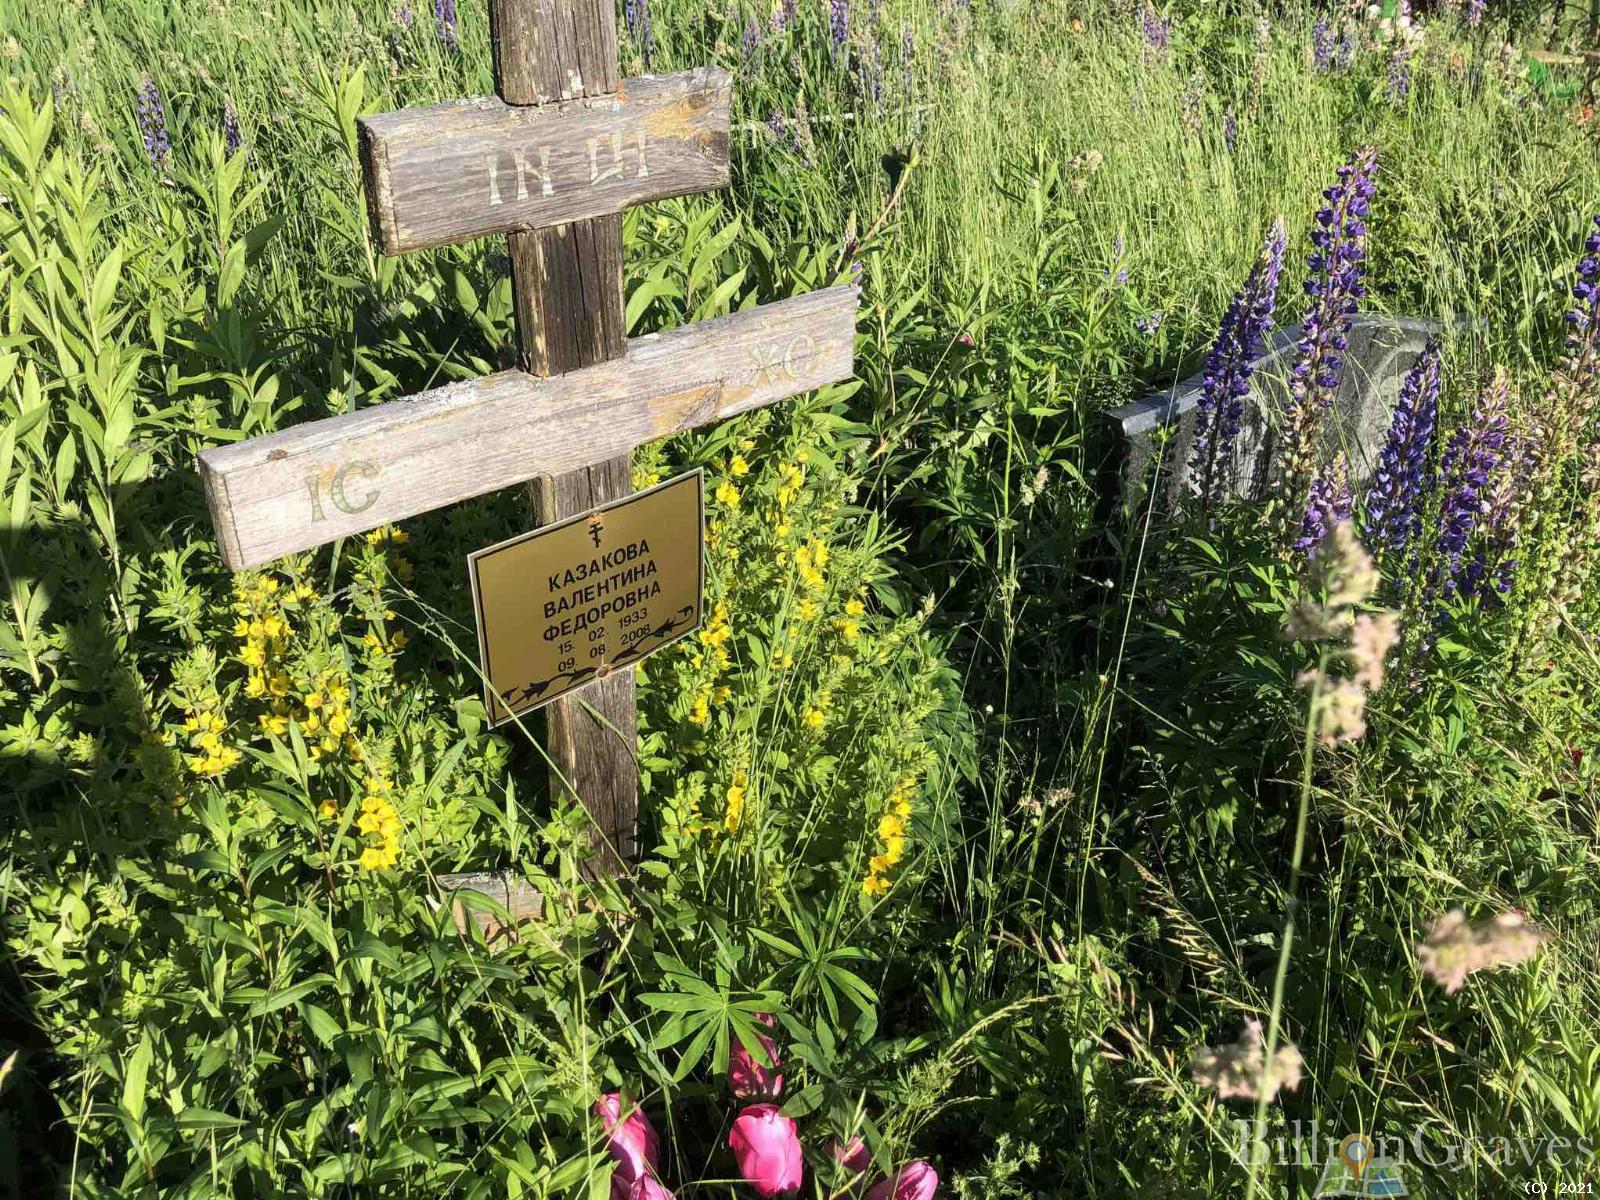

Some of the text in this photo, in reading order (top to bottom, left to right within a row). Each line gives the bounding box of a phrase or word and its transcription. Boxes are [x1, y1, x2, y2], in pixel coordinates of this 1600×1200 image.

[543, 559, 657, 618] ВАЛЕНТИНА
[548, 539, 650, 592] КАЗАКОВА
[543, 580, 661, 641] ФЕДОРОВНА
[558, 640, 576, 654] 15.
[618, 607, 648, 629] 1933
[558, 657, 578, 672] 09.
[620, 623, 651, 645] 2008
